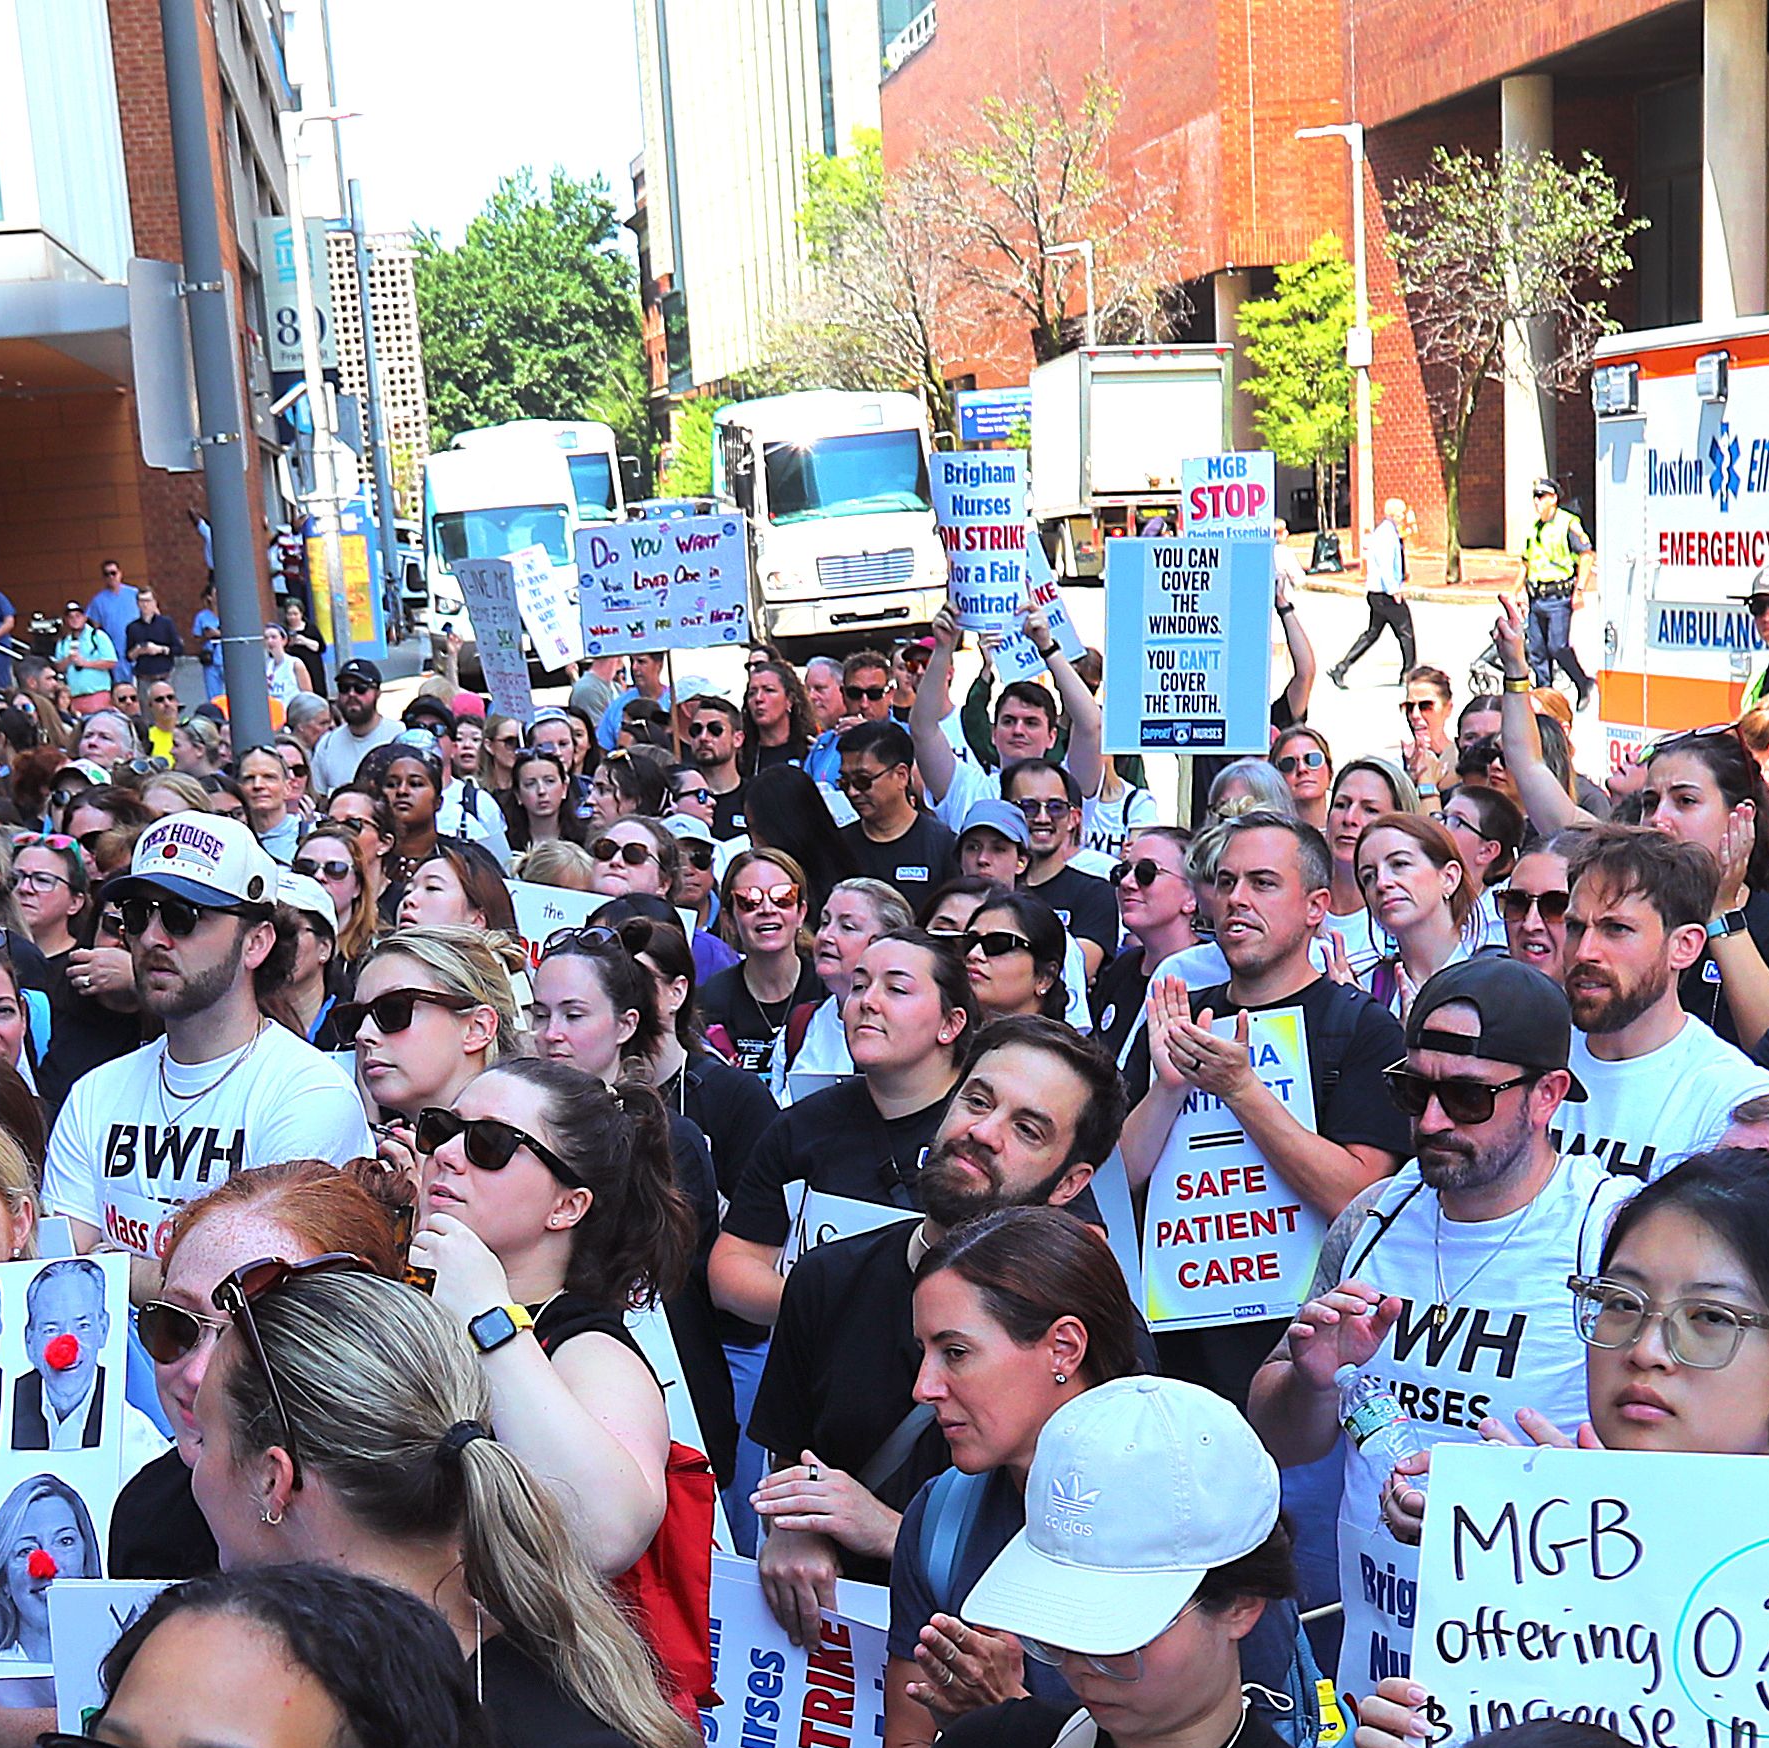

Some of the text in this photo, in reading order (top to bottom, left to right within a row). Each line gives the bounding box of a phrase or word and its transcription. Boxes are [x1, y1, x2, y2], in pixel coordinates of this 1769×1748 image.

[944, 461, 1016, 488] Brigham
[1207, 455, 1249, 481] MGB
[1648, 447, 1704, 497] Boston
[952, 494, 1012, 517] Nurses
[1190, 483, 1267, 522] STOP
[590, 533, 721, 570] Do YOU WANT
[965, 525, 1026, 552] STRIKE
[1152, 547, 1219, 569] YOU CAN
[974, 560, 1021, 584] a Fair
[1161, 571, 1210, 592] COVER
[1171, 593, 1199, 614] THE
[1148, 615, 1223, 636] WINDOWS.
[1147, 649, 1222, 671] YOU CAN'T
[1160, 672, 1206, 693] COVER
[1144, 694, 1222, 715] THE TRUTH.
[1141, 727, 1223, 742] SUPPORT NURSES
[170, 823, 226, 865] HOUSE
[1089, 832, 1126, 855] WH
[542, 902, 566, 920] the
[104, 1123, 245, 1183] BWH
[1176, 1164, 1267, 1201] SAFE
[103, 1200, 149, 1253] Mass
[1157, 1203, 1302, 1249] PATIENT
[1178, 1252, 1281, 1290] CARE
[1233, 1305, 1265, 1319] MNA
[1391, 1298, 1528, 1379] WH
[1449, 1497, 1645, 1584] MGB
[1436, 1604, 1663, 1695] offering
